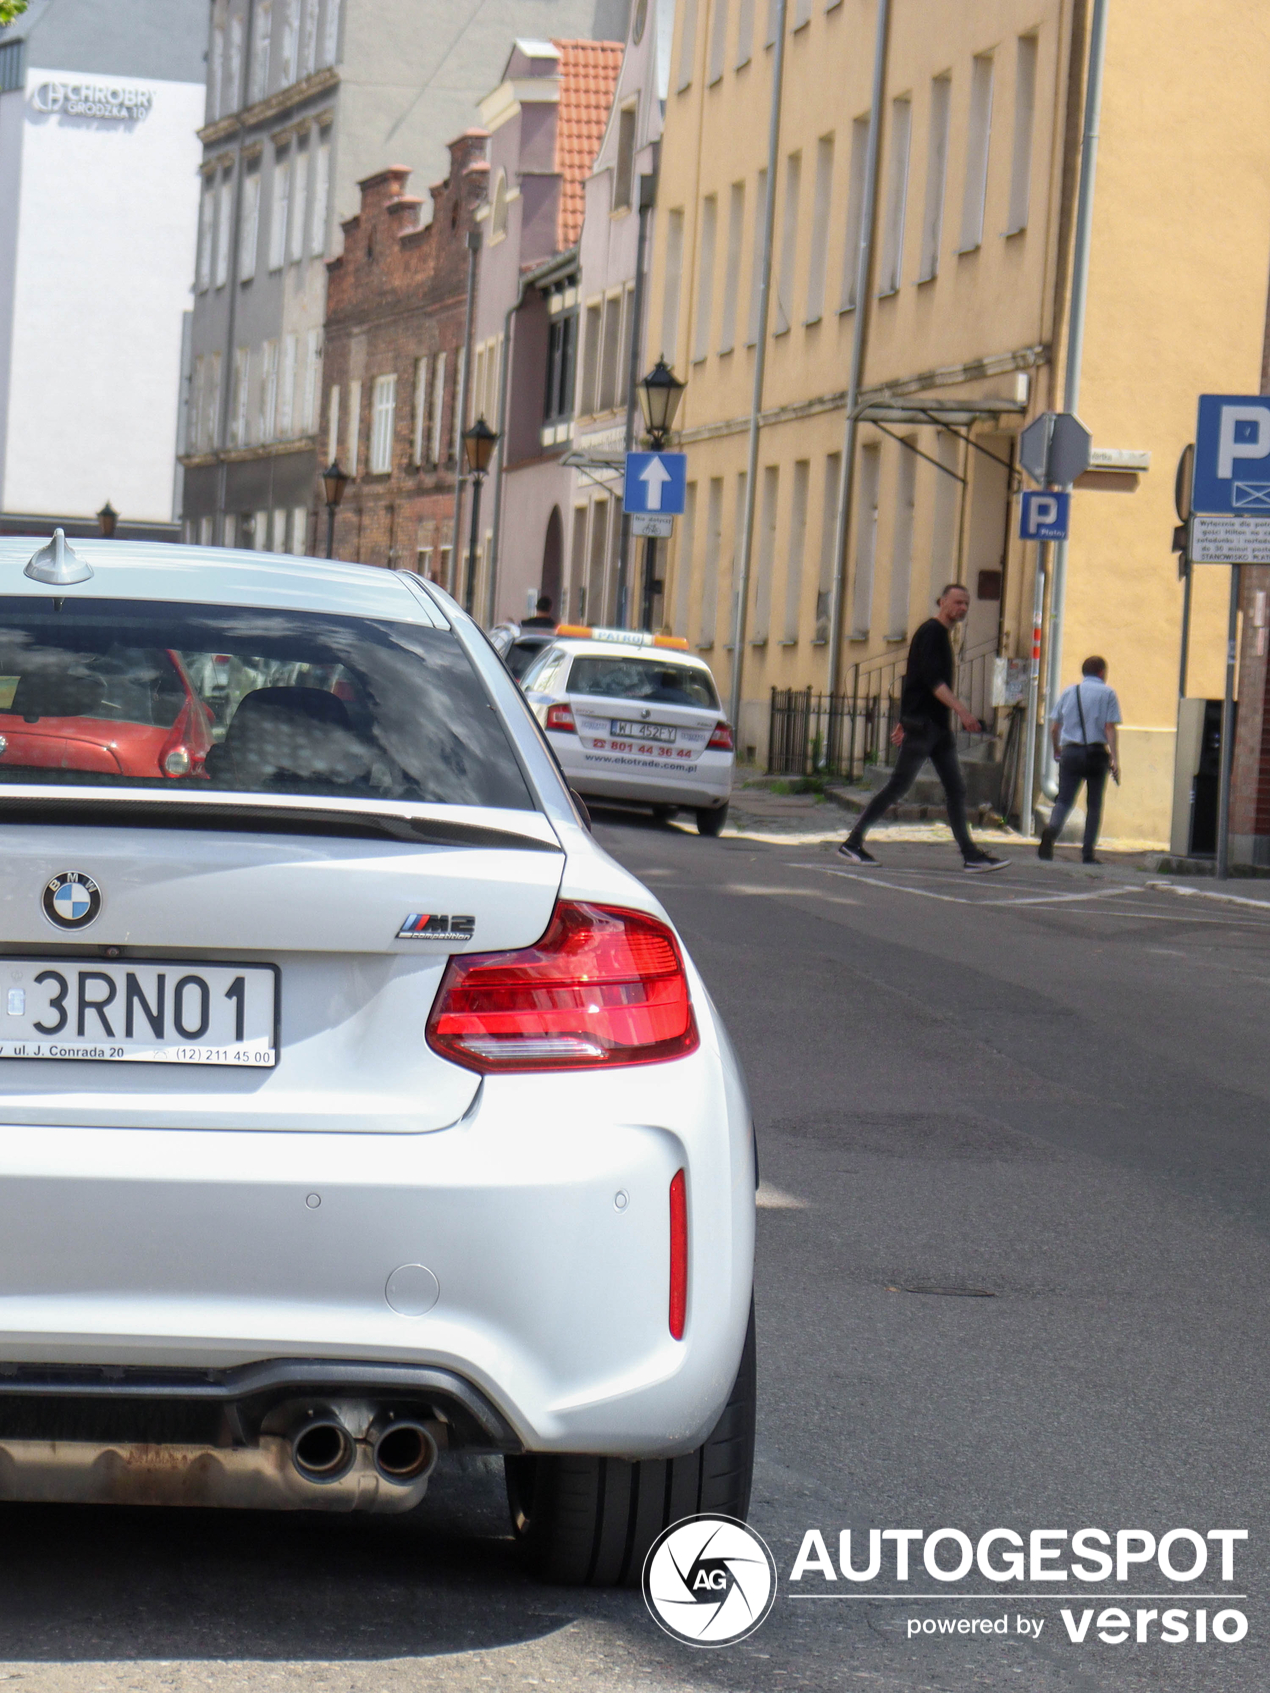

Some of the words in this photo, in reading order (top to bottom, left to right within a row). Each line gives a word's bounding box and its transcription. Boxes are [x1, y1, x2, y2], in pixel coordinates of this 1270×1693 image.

[68, 101, 128, 118] GRODZKA
[132, 106, 146, 119] 10
[1217, 405, 1270, 479] P
[1028, 496, 1057, 534] P
[610, 741, 633, 752] 801
[638, 744, 653, 755] 44
[658, 747, 673, 757] 36
[677, 749, 693, 759] 44
[585, 754, 697, 773] www.ekotrade.com.pl
[48, 872, 99, 893] BMW
[412, 932, 471, 940] competition
[32, 970, 246, 1042] 3RN01
[13, 1043, 30, 1056] ul.
[32, 1044, 45, 1057] J.
[49, 1045, 106, 1058] Conrada
[109, 1046, 124, 1058] 20
[176, 1046, 202, 1062] (12)
[205, 1050, 228, 1062] 211
[234, 1050, 251, 1062] 45
[254, 1051, 270, 1063] 00
